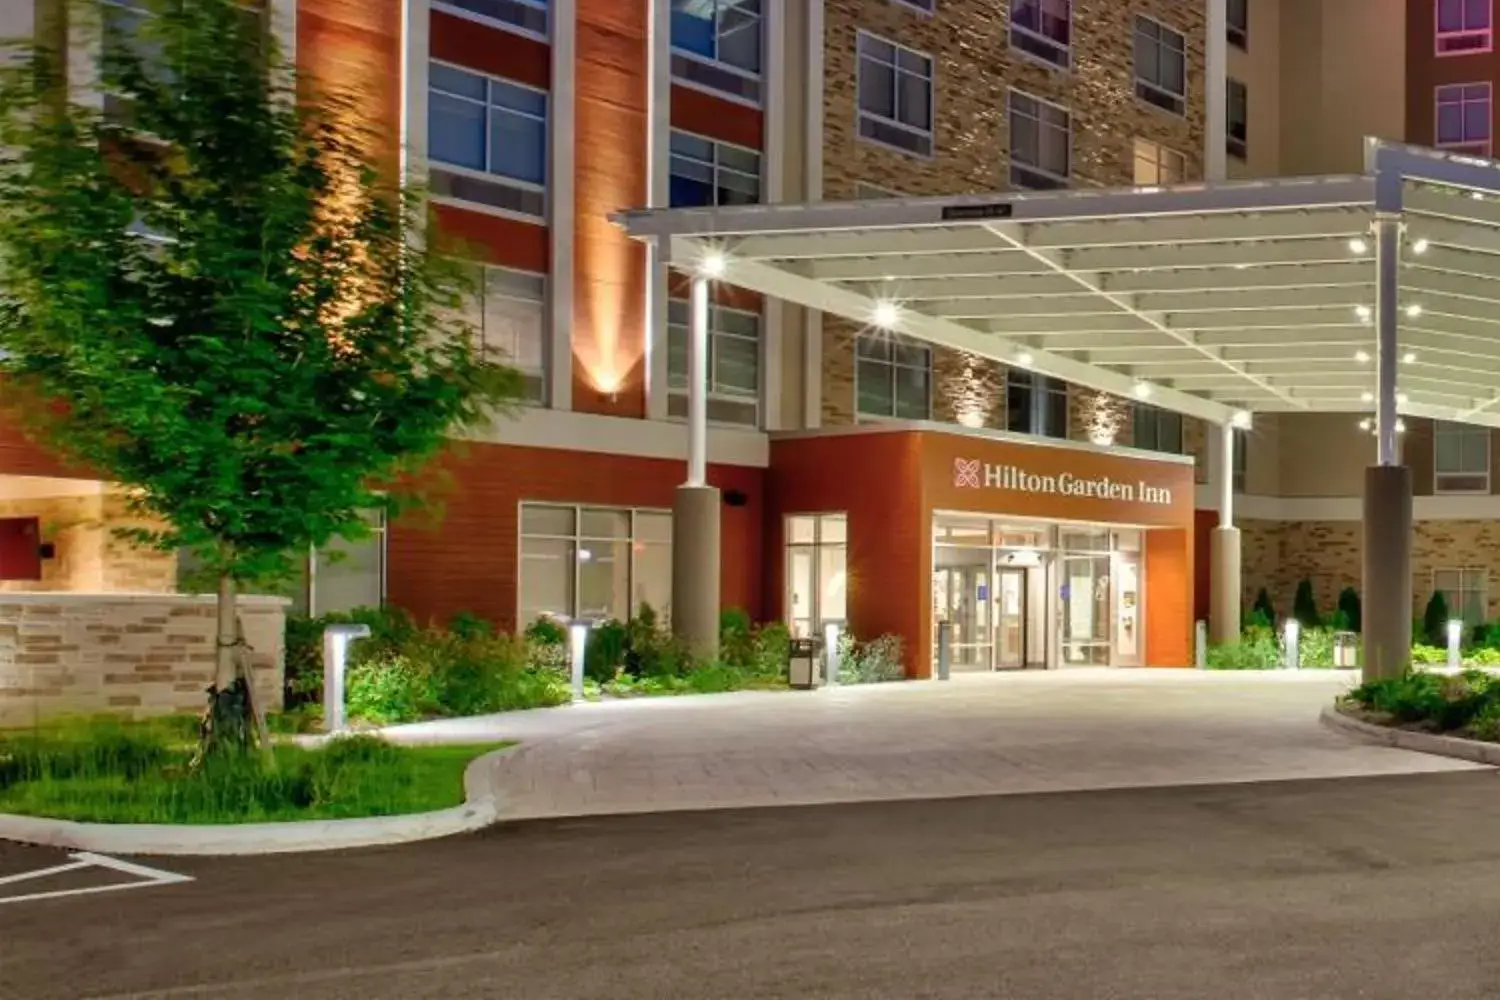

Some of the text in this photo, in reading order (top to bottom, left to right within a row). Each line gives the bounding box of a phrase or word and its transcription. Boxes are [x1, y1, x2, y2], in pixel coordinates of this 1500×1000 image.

[984, 463, 1172, 504] Hilton Garden Inn
